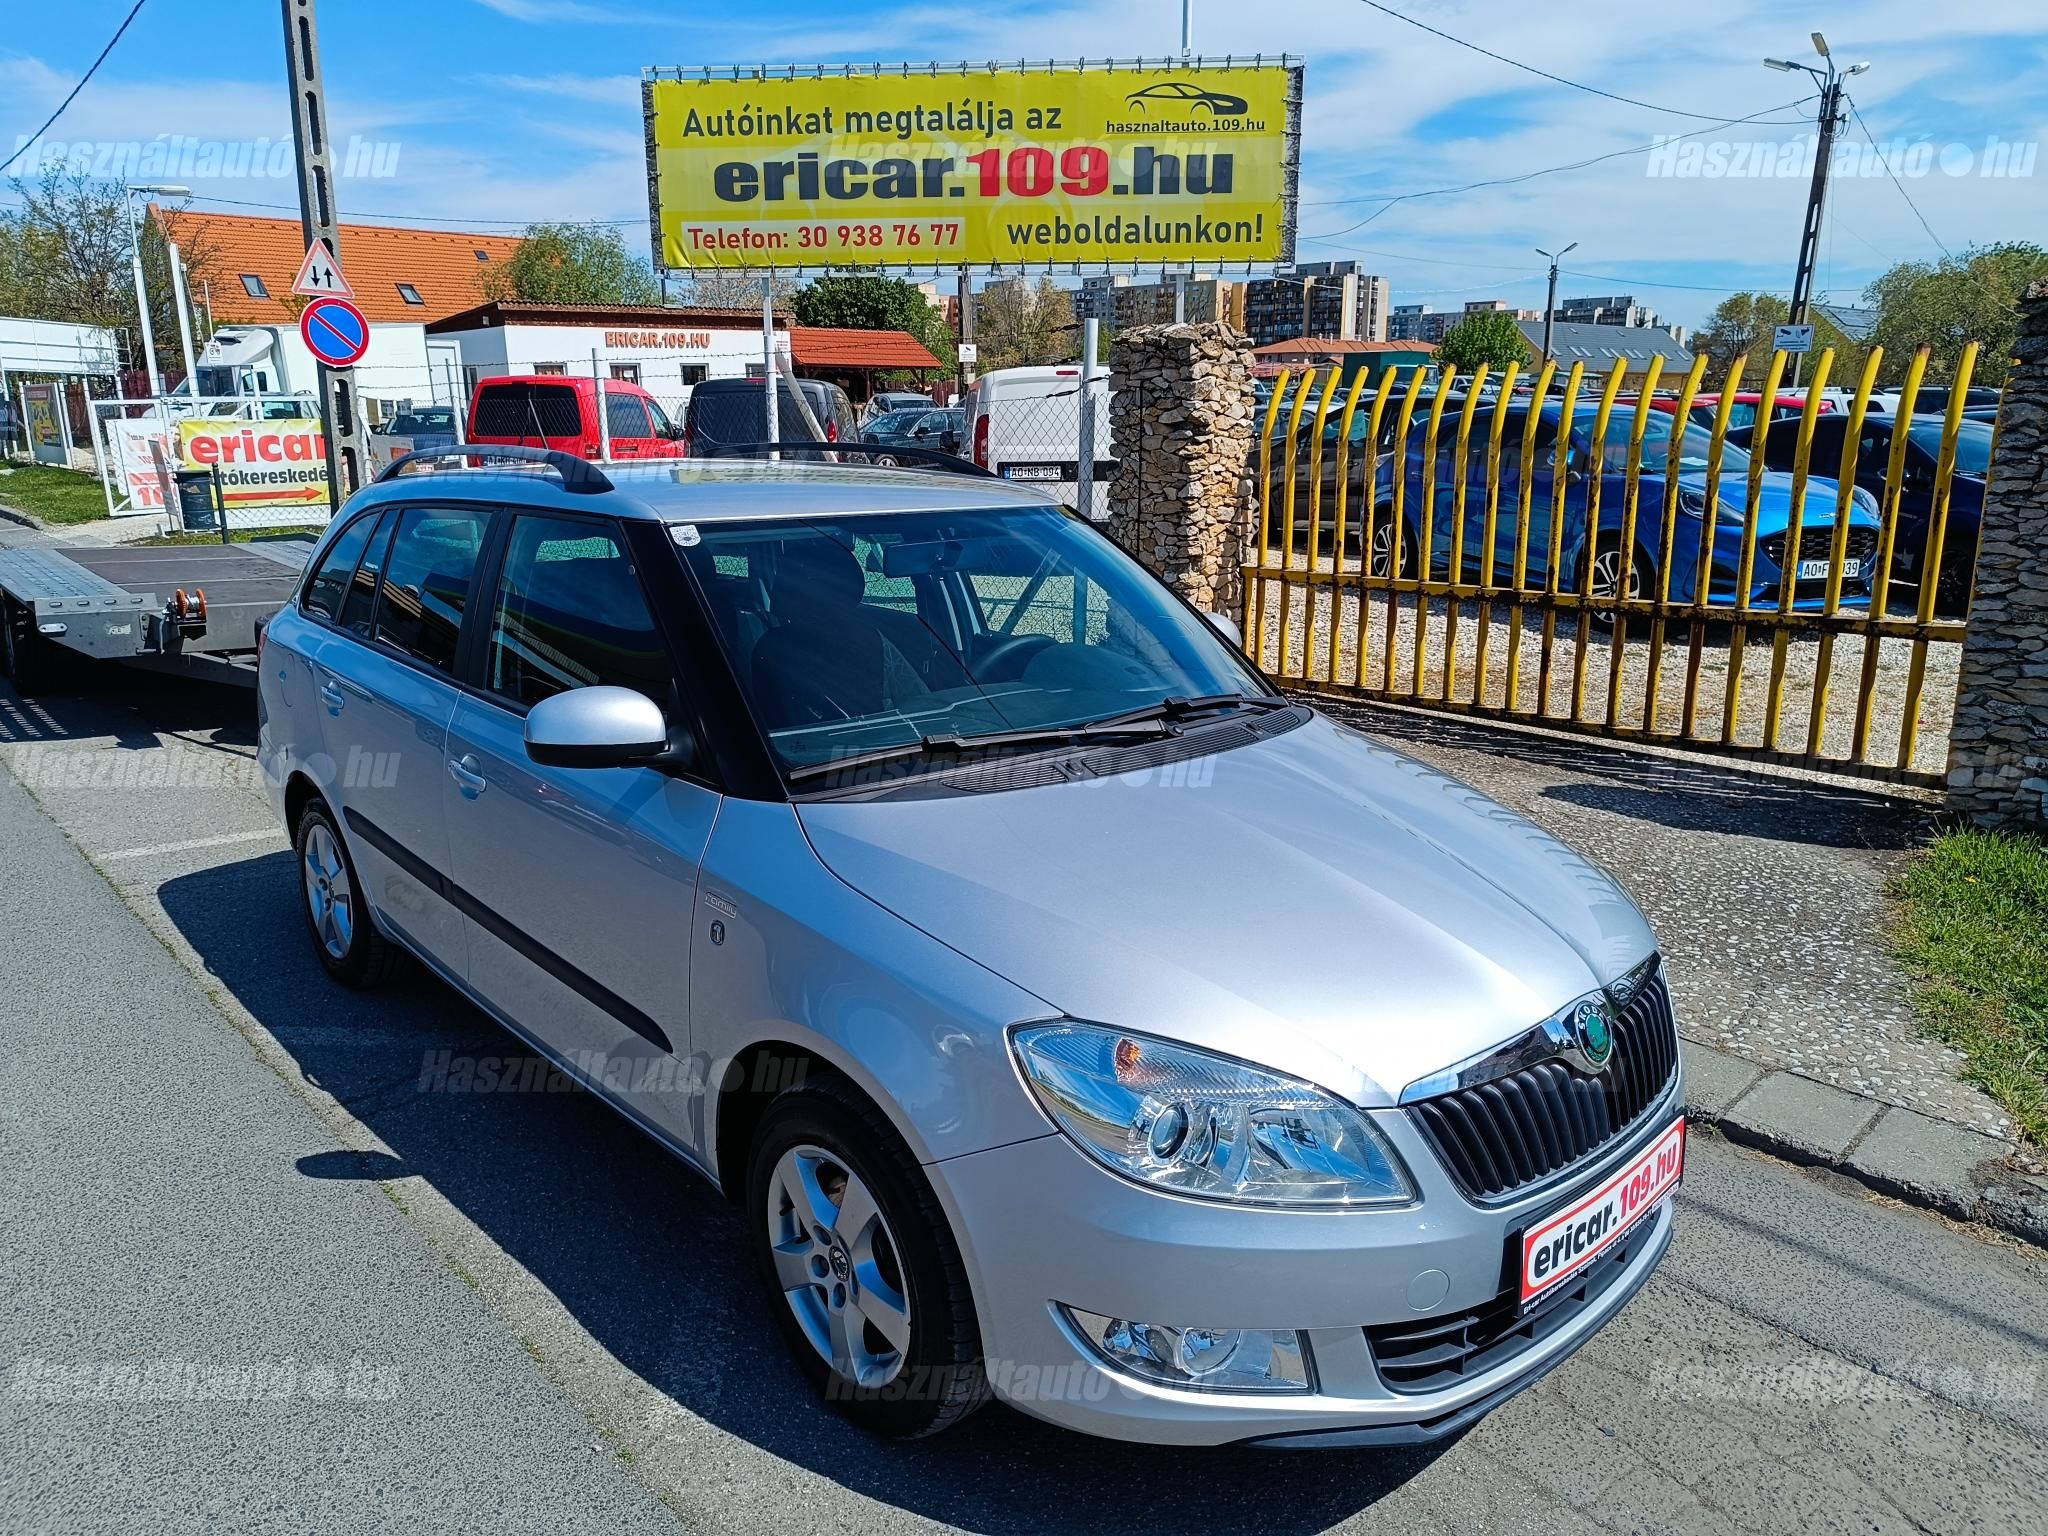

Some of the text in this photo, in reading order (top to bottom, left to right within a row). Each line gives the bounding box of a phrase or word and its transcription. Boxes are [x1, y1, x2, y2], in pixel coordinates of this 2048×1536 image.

[683, 97, 1062, 140] Autóinkat megtalálja az
[1106, 118, 1266, 133] hasznaltauto.109.hu
[714, 147, 1234, 202] ericar.109.hu
[688, 223, 959, 250] Telefon: 30 938 76 77
[1006, 213, 1263, 245] weboldalunkon!
[605, 331, 711, 349] ERICAR.109.HU
[1803, 562, 1818, 577] AO
[1534, 1142, 1678, 1279] ericar.109.hu
